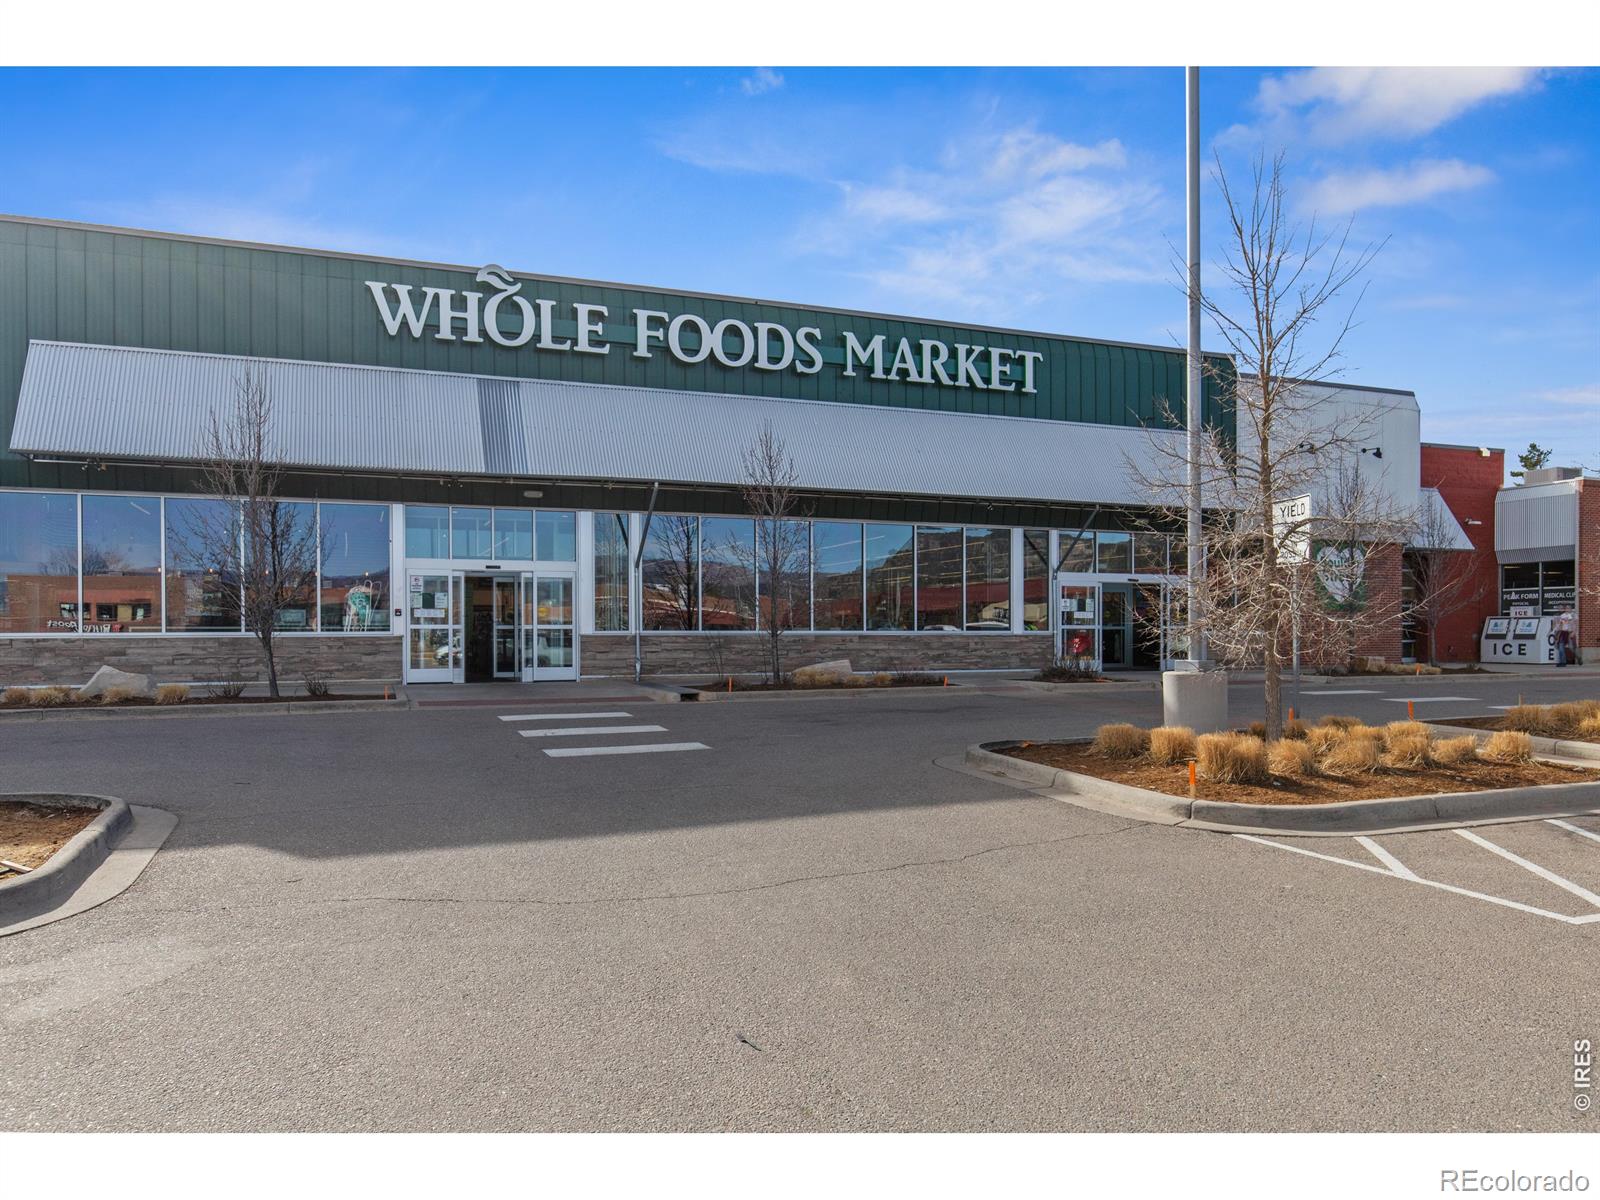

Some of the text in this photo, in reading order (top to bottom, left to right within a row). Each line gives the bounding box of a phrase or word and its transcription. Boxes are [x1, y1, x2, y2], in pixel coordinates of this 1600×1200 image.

[365, 279, 1044, 394] WHOLE FOODS MARKET
[1280, 502, 1306, 518] YIELD
[1503, 591, 1520, 600] PEAK
[1493, 643, 1527, 656] ICE
